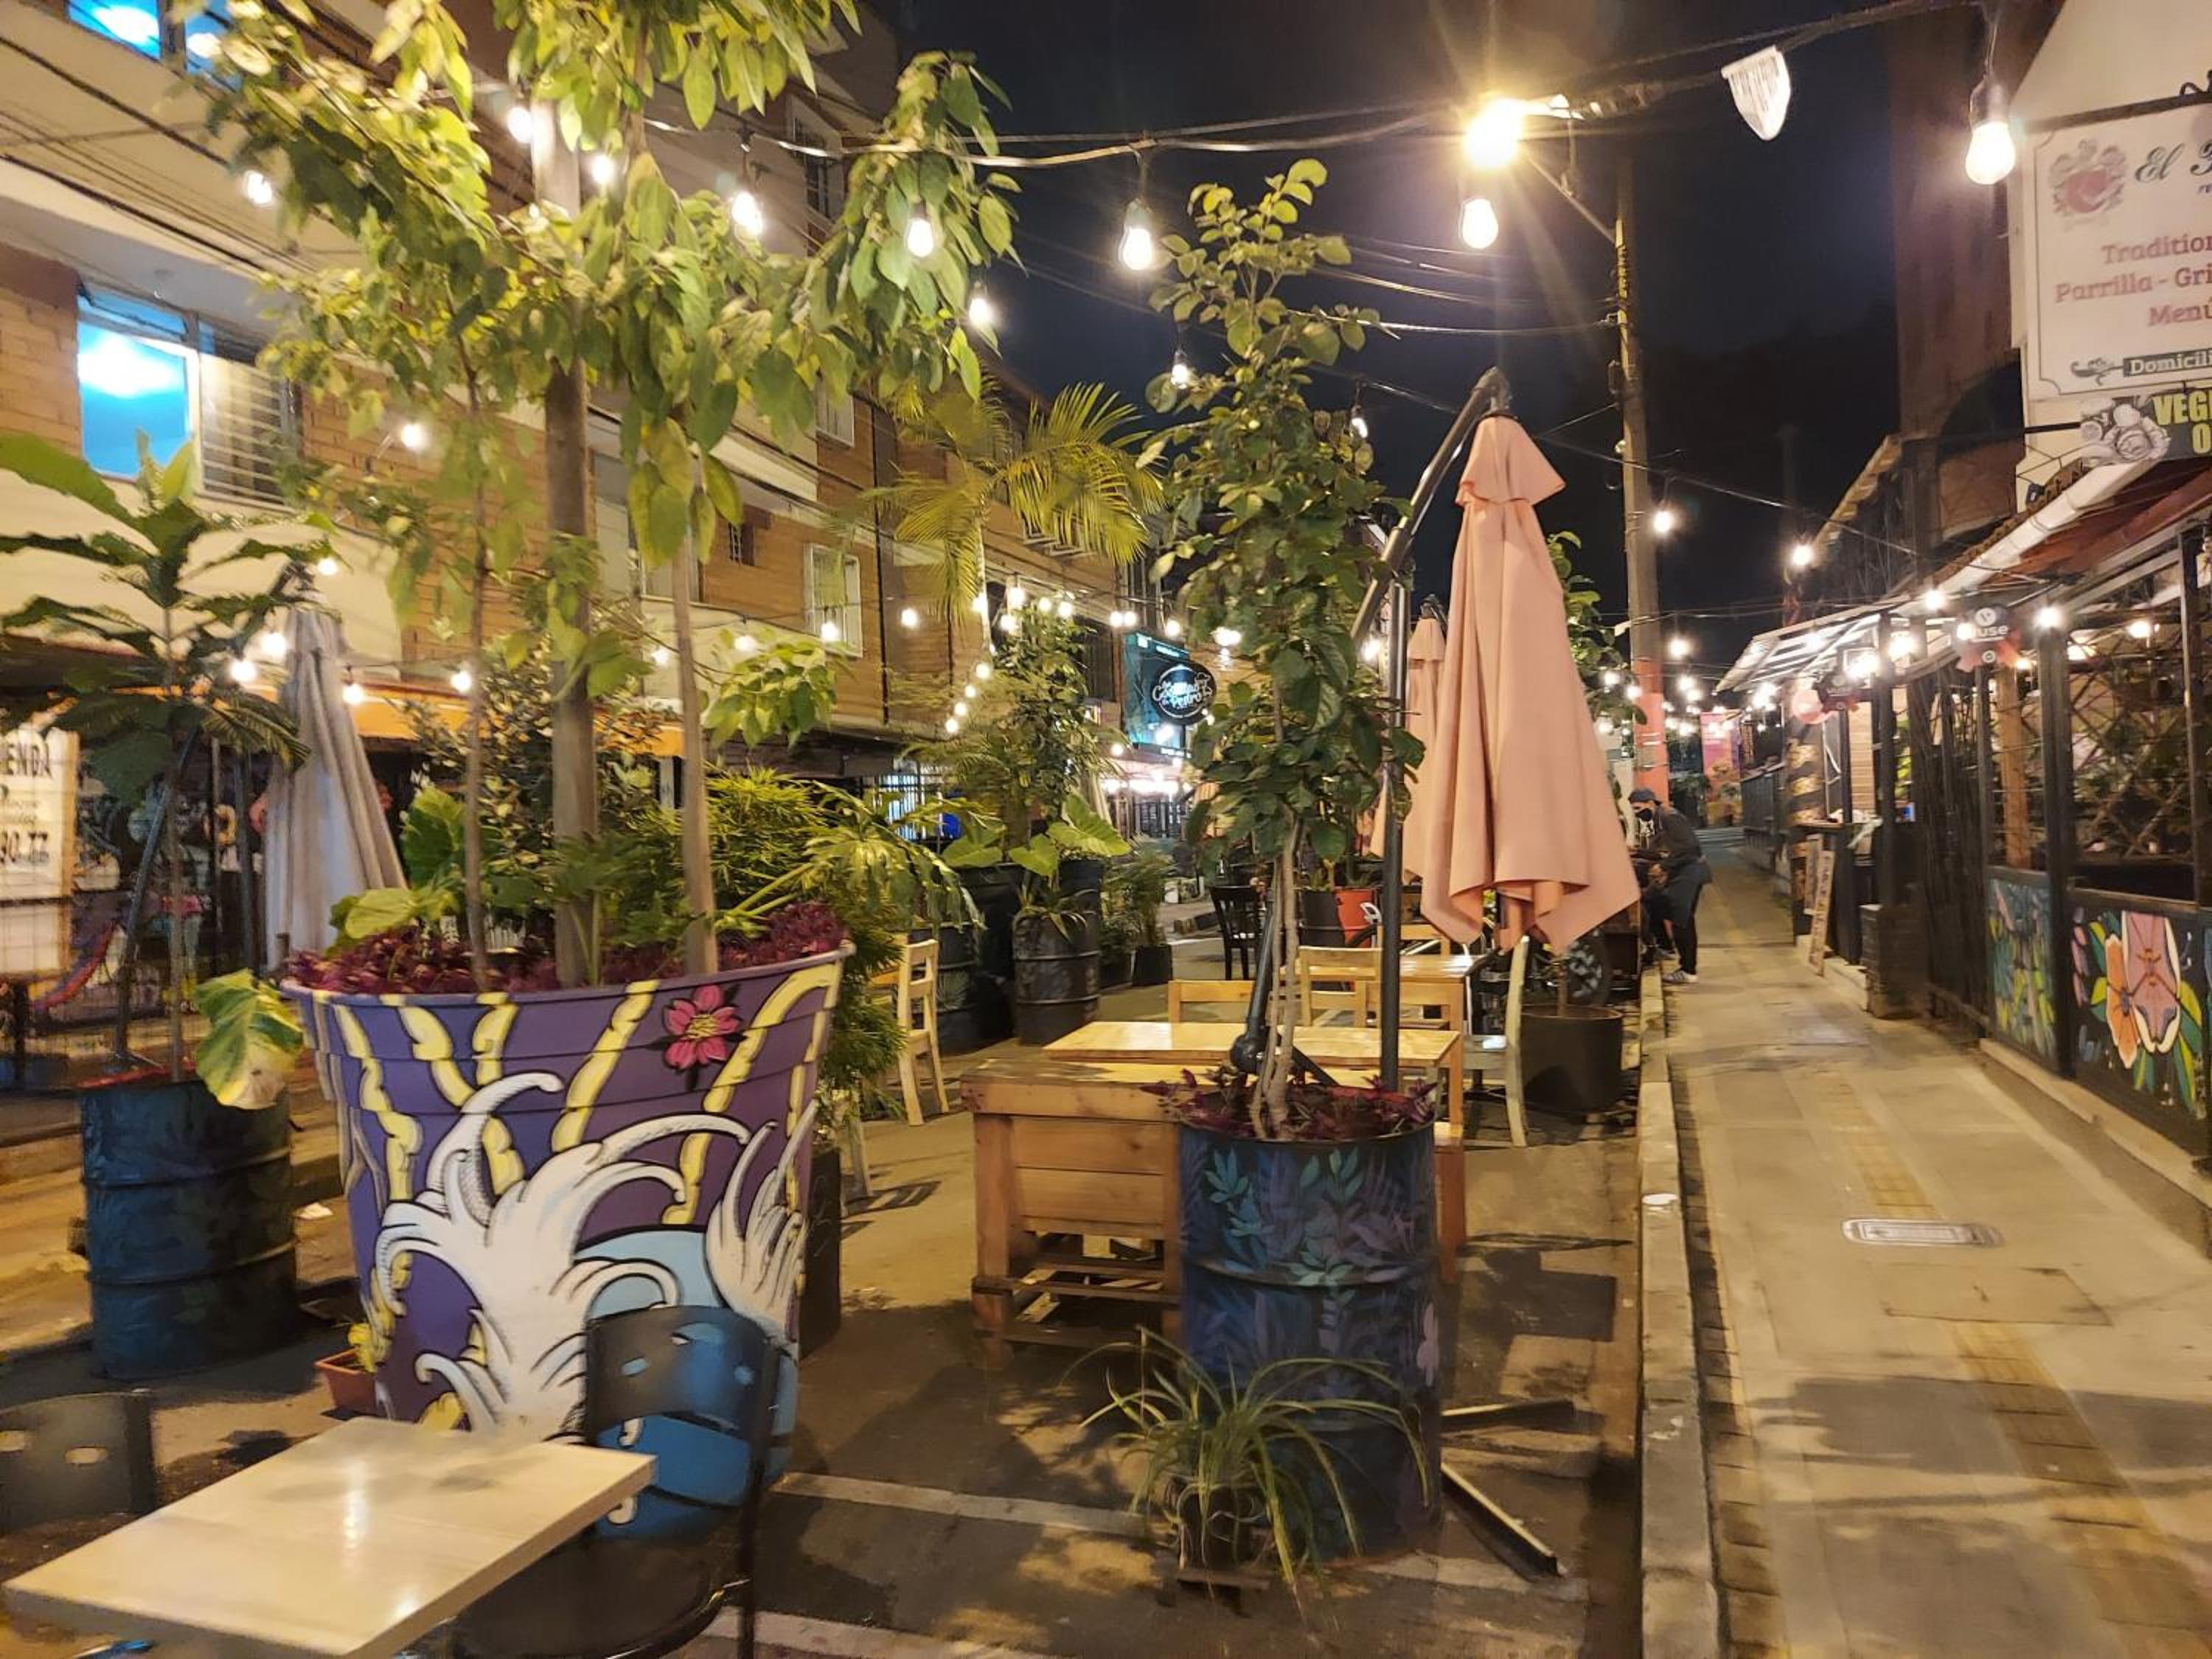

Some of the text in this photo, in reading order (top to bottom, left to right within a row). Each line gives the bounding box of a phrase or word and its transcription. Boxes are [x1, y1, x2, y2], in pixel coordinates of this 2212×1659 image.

[2135, 142, 2185, 184] El
[2055, 272, 2153, 304] Parrilla
[2153, 389, 2212, 425] VEG
